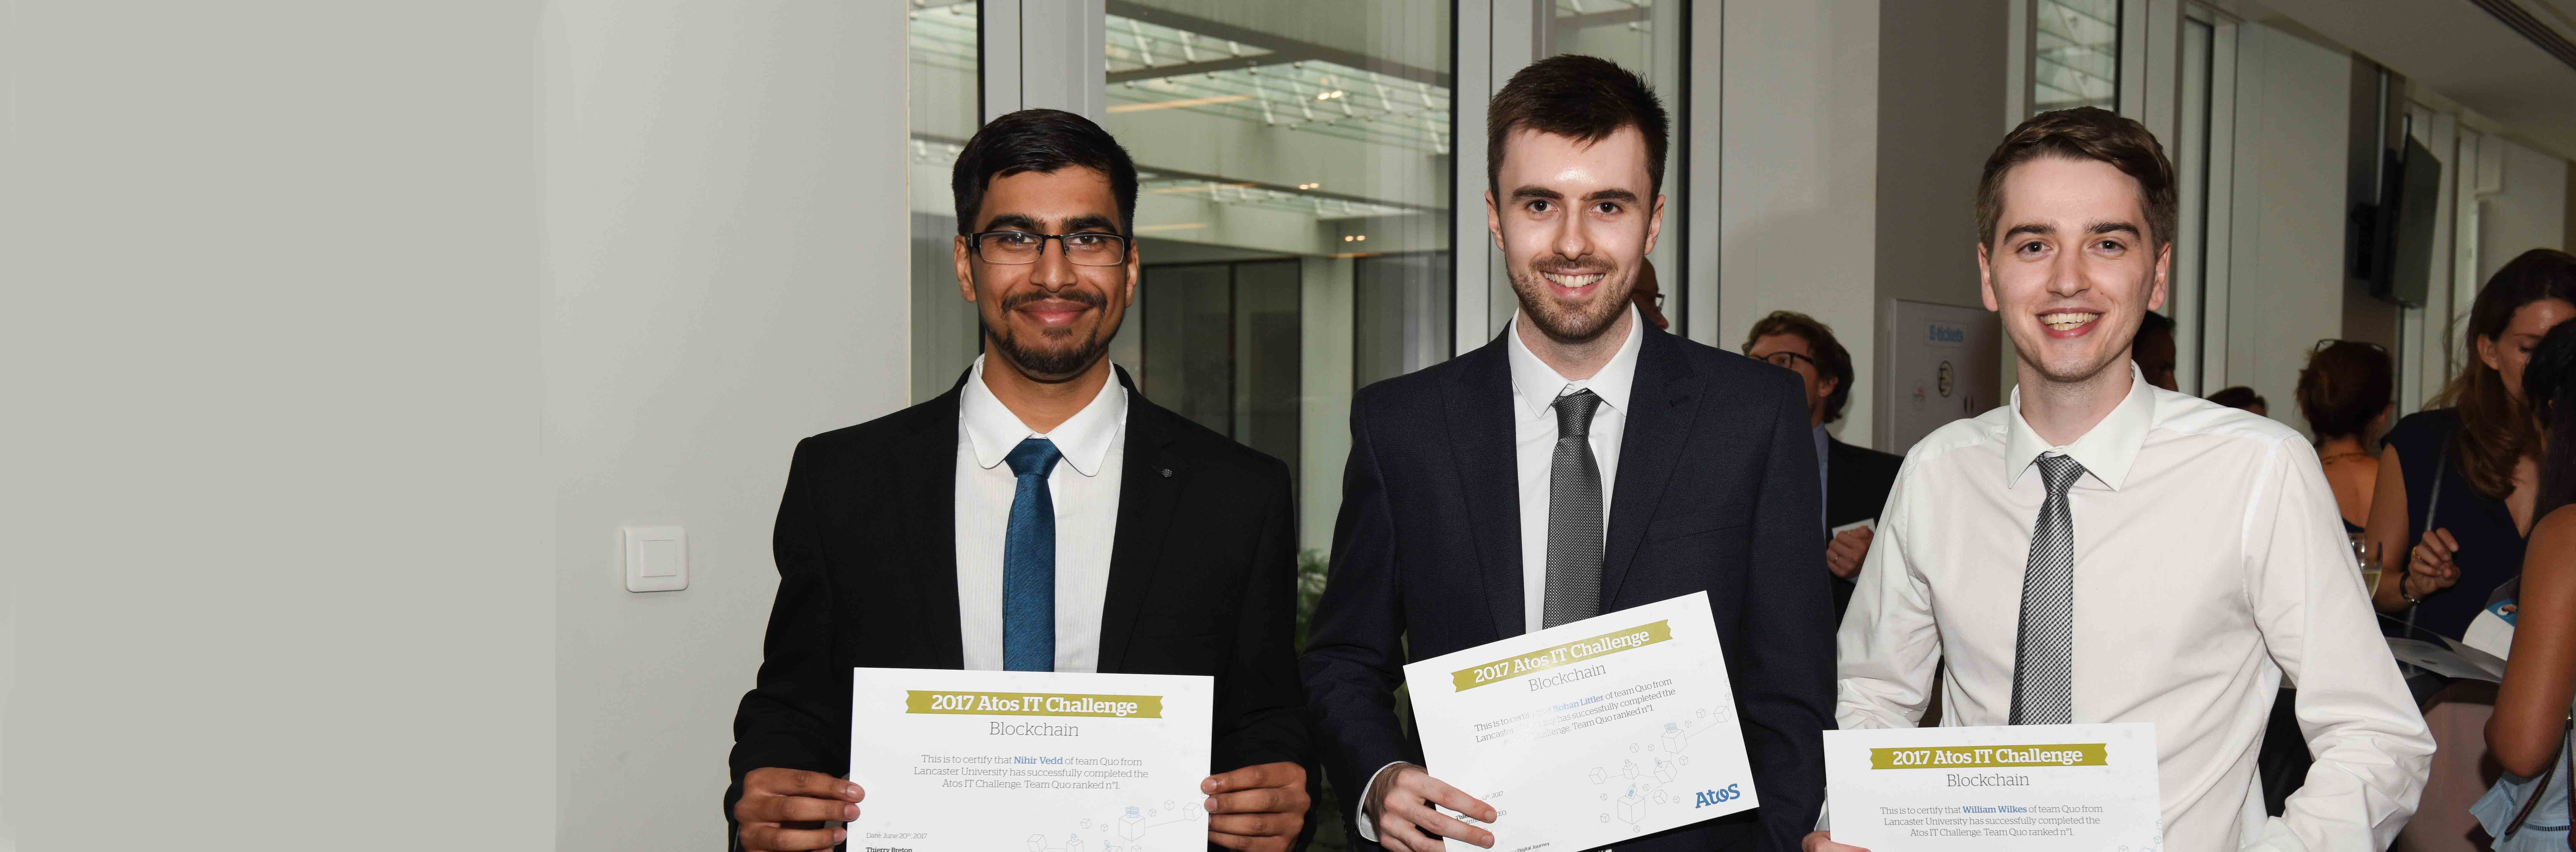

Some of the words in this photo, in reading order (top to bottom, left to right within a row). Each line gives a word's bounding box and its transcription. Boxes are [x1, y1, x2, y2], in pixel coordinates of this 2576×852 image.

[1474, 662, 1509, 683] 2017
[1514, 656, 1550, 673] Atos
[1552, 648, 1567, 663] IT
[1571, 631, 1650, 658] Challenge
[1528, 665, 1606, 692] Blockchain
[931, 695, 974, 710] 2017
[977, 696, 1019, 711] Atos
[1022, 697, 1043, 711] IT
[1046, 697, 1137, 716] Challenge
[1474, 723, 1492, 731] This
[1553, 701, 1579, 712] Rohan
[1580, 695, 1604, 706] Littler
[1614, 688, 1635, 697] team
[1635, 684, 1652, 692] Quo
[1653, 679, 1672, 688] from
[1476, 728, 1514, 743] Lancaster
[1572, 702, 1618, 719] successfully
[1620, 691, 1662, 707] completed
[1572, 720, 1595, 730] Team
[1596, 716, 1612, 724] Quo
[1613, 707, 1641, 720] ranked
[990, 722, 1079, 736] Blockchain
[963, 756, 992, 765] certify
[1100, 758, 1119, 766] Quo
[1893, 751, 1930, 765] 2017
[1934, 751, 1972, 764] Atos
[1974, 749, 1992, 763] IT
[1996, 749, 2082, 765] Challenge
[914, 767, 959, 775] Lancaster
[961, 768, 1008, 777] University
[1027, 769, 1082, 778] successfully
[1084, 770, 1131, 778] completed
[1947, 774, 2029, 786] Blockchain
[976, 780, 1022, 789] Challenge.
[1052, 781, 1071, 789] Quo
[1695, 783, 1740, 808] Atos
[1917, 807, 1943, 815] certify
[1985, 817, 2036, 825] successfully
[2039, 817, 2084, 825] completed
[1940, 829, 1982, 837] Challenge.
[2009, 828, 2027, 836] Quo
